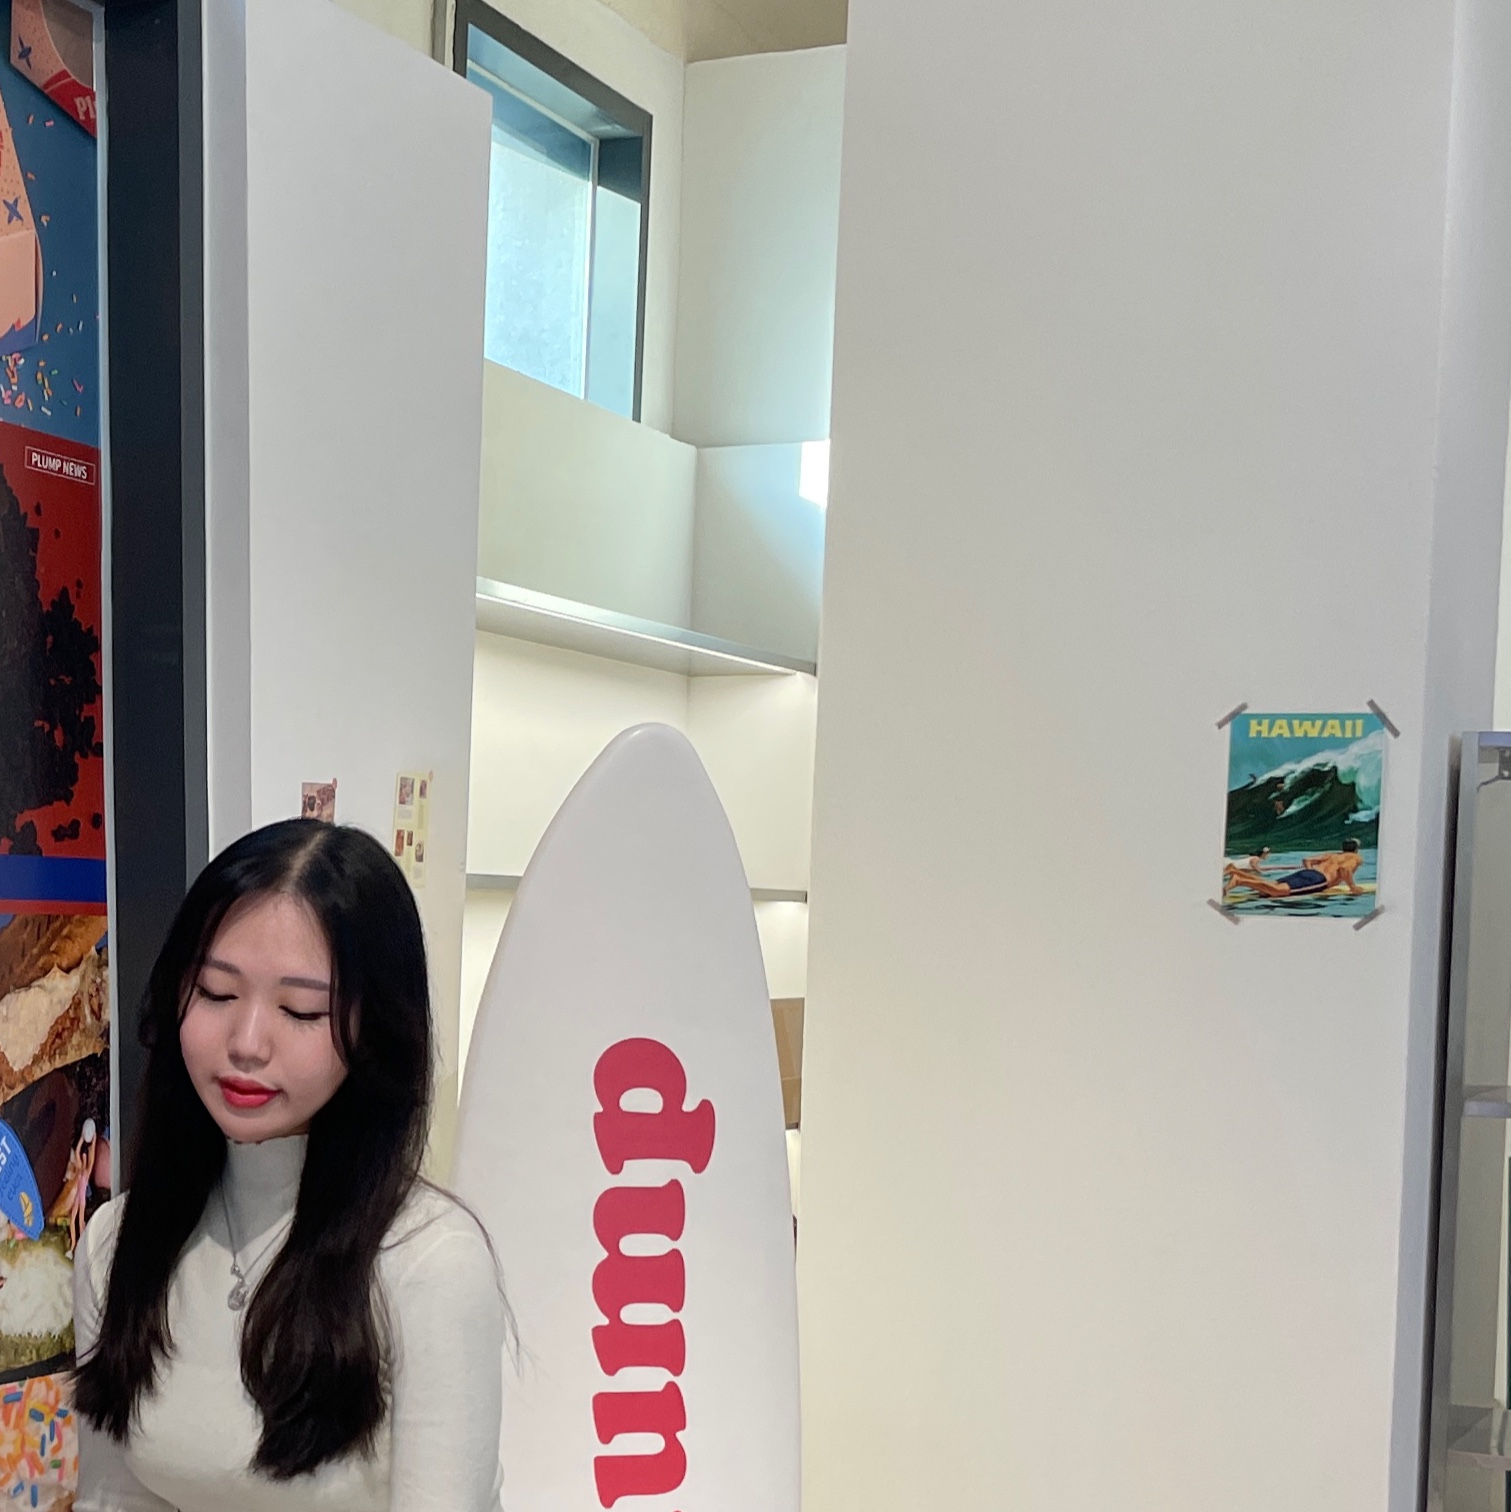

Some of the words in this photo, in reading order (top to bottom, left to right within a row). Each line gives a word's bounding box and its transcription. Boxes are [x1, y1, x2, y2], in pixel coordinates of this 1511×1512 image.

[31, 452, 61, 474] PLUMP
[61, 459, 88, 480] NEWS
[1248, 718, 1364, 739] HAWAII
